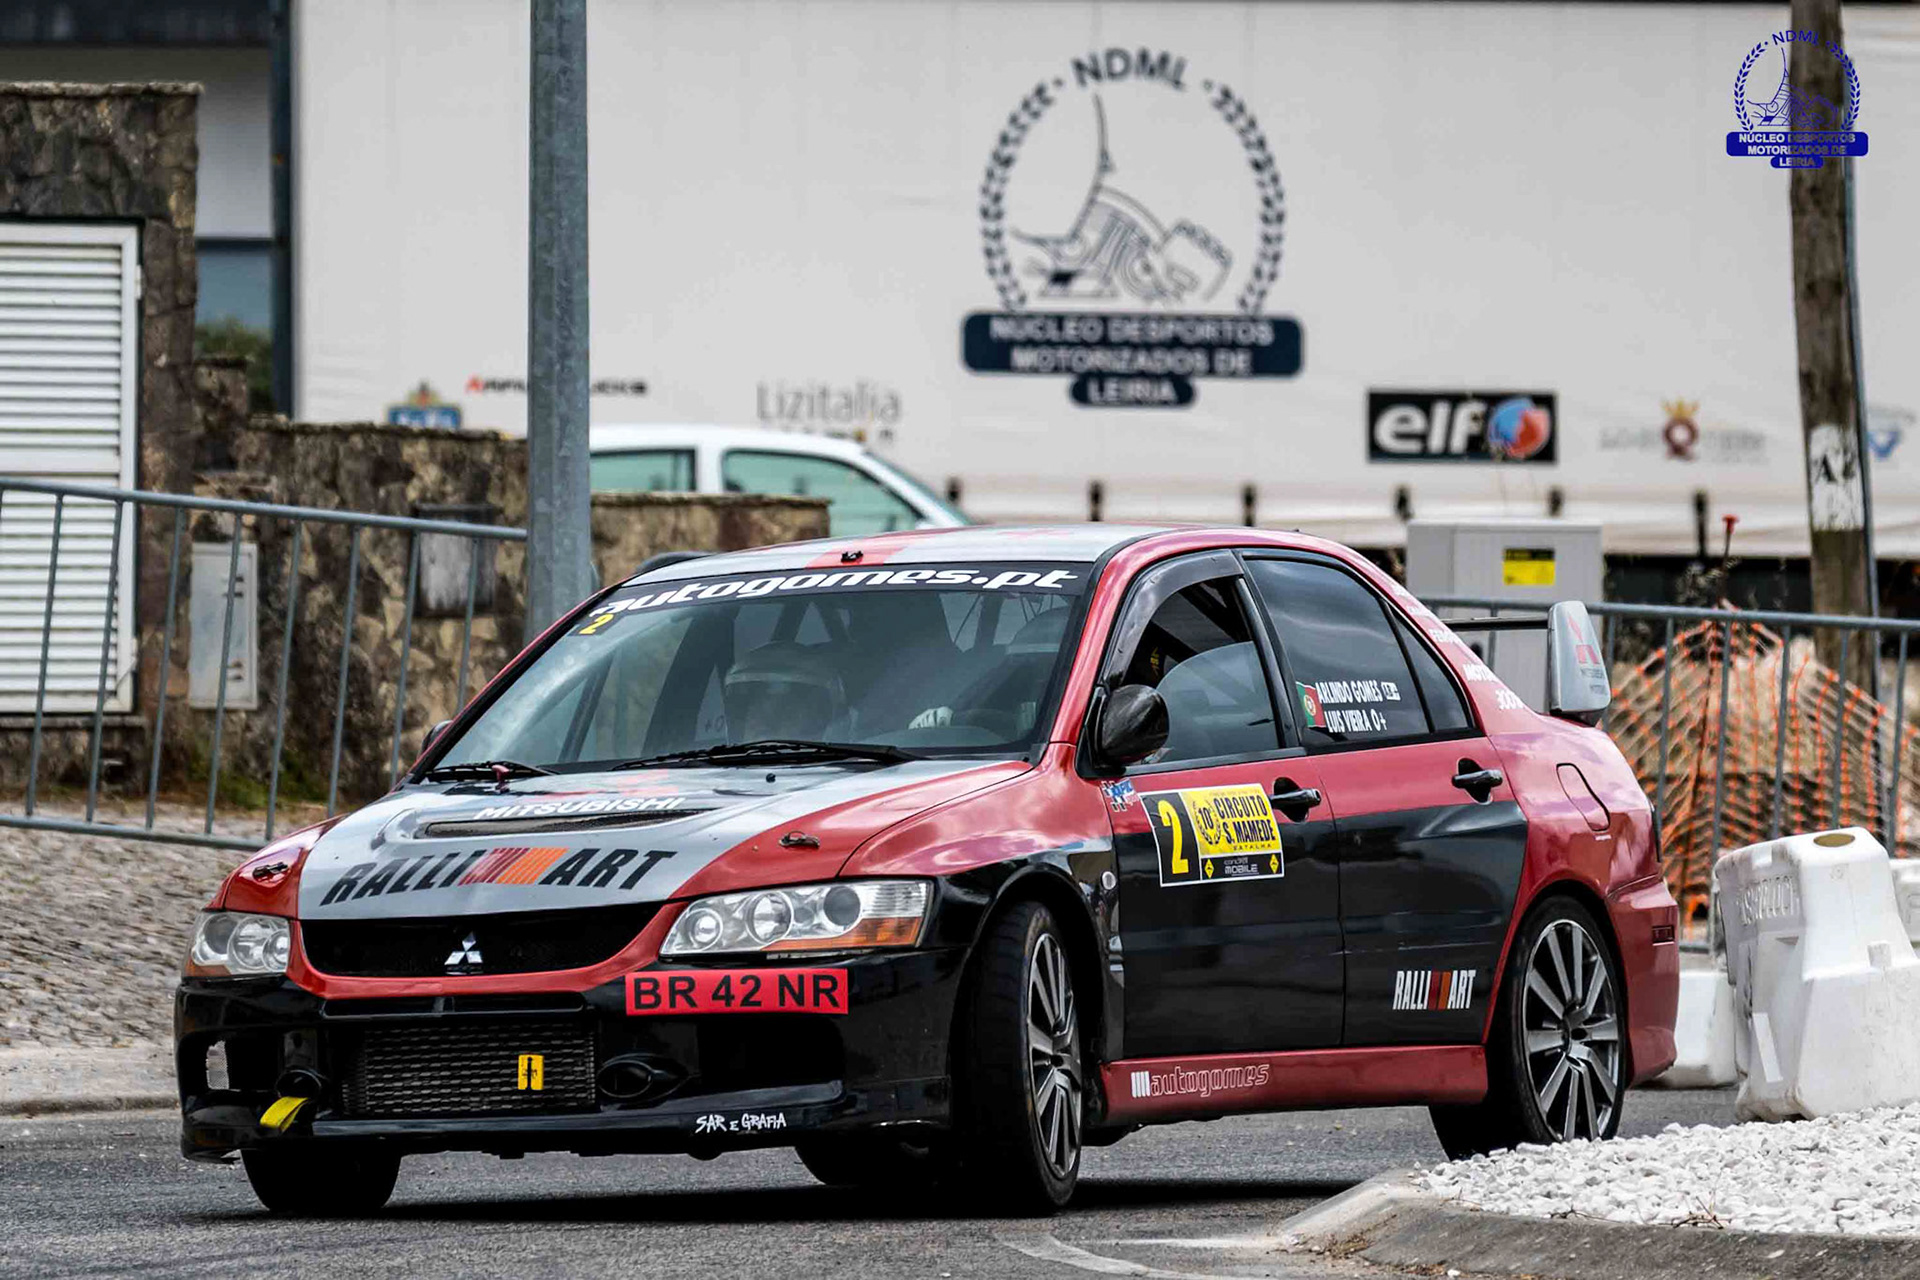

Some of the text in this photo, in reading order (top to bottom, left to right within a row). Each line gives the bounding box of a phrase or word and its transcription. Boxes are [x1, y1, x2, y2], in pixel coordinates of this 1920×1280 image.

[1071, 47, 1187, 90] NDML
[1106, 318, 1275, 347] DESPORTOS
[1010, 346, 1251, 375] MOTORIZADOS DE
[755, 380, 903, 422] Lizitalia
[1087, 376, 1179, 402] LEIRIA
[1374, 402, 1489, 456] elf
[588, 568, 1079, 618] autogomes.pt
[578, 613, 615, 634] 2
[473, 796, 687, 820] MITSUBISHI
[1213, 794, 1268, 820] CIRCUITO
[1157, 799, 1190, 875] 2
[1232, 818, 1276, 843] MAMEDE
[633, 973, 840, 1010] BR 42 NR
[1150, 1063, 1271, 1098] autogomes
